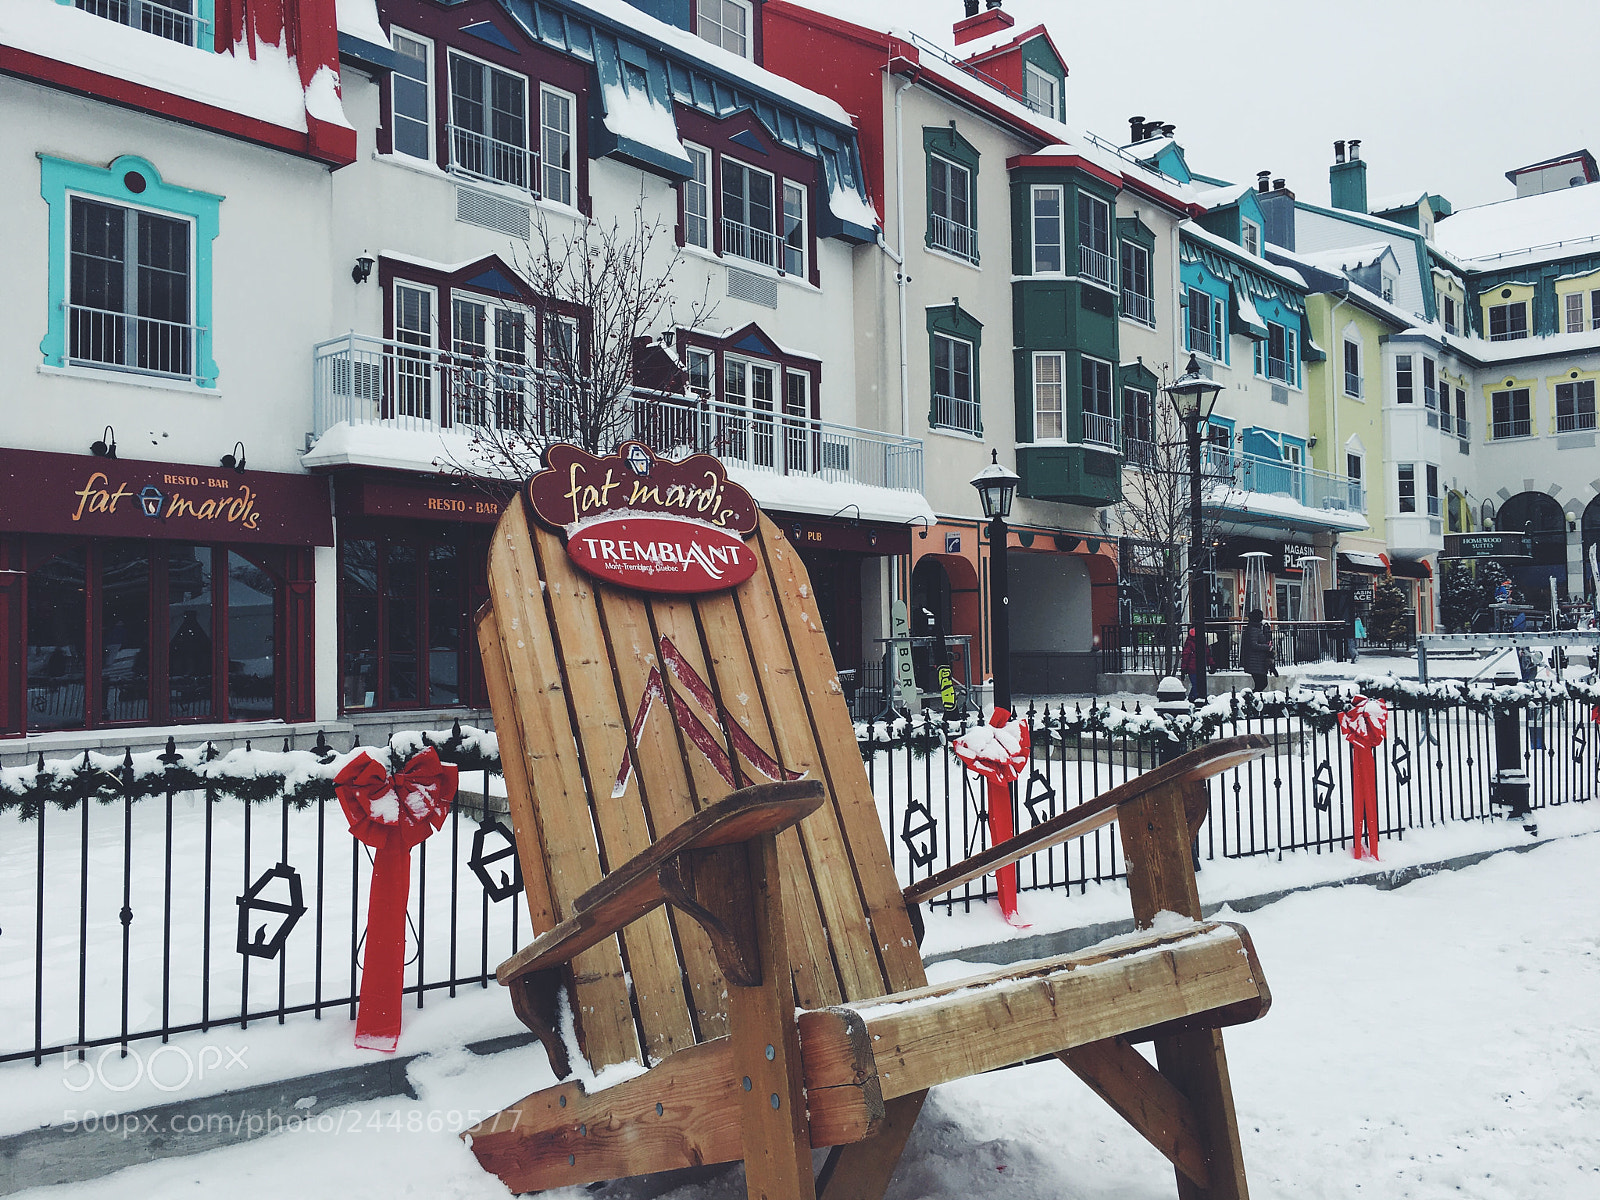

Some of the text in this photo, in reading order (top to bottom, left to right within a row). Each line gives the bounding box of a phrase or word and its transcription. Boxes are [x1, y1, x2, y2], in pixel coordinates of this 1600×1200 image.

[164, 474, 198, 486] RESTO
[207, 478, 229, 489] BAR
[72, 472, 261, 529] fat mardis
[563, 462, 734, 526] fat mardis
[428, 498, 466, 512] RESTO
[475, 502, 498, 514] BAR
[807, 531, 822, 541] PUB
[1284, 543, 1315, 556] MAGASIN
[582, 538, 740, 580] TREMBLANT
